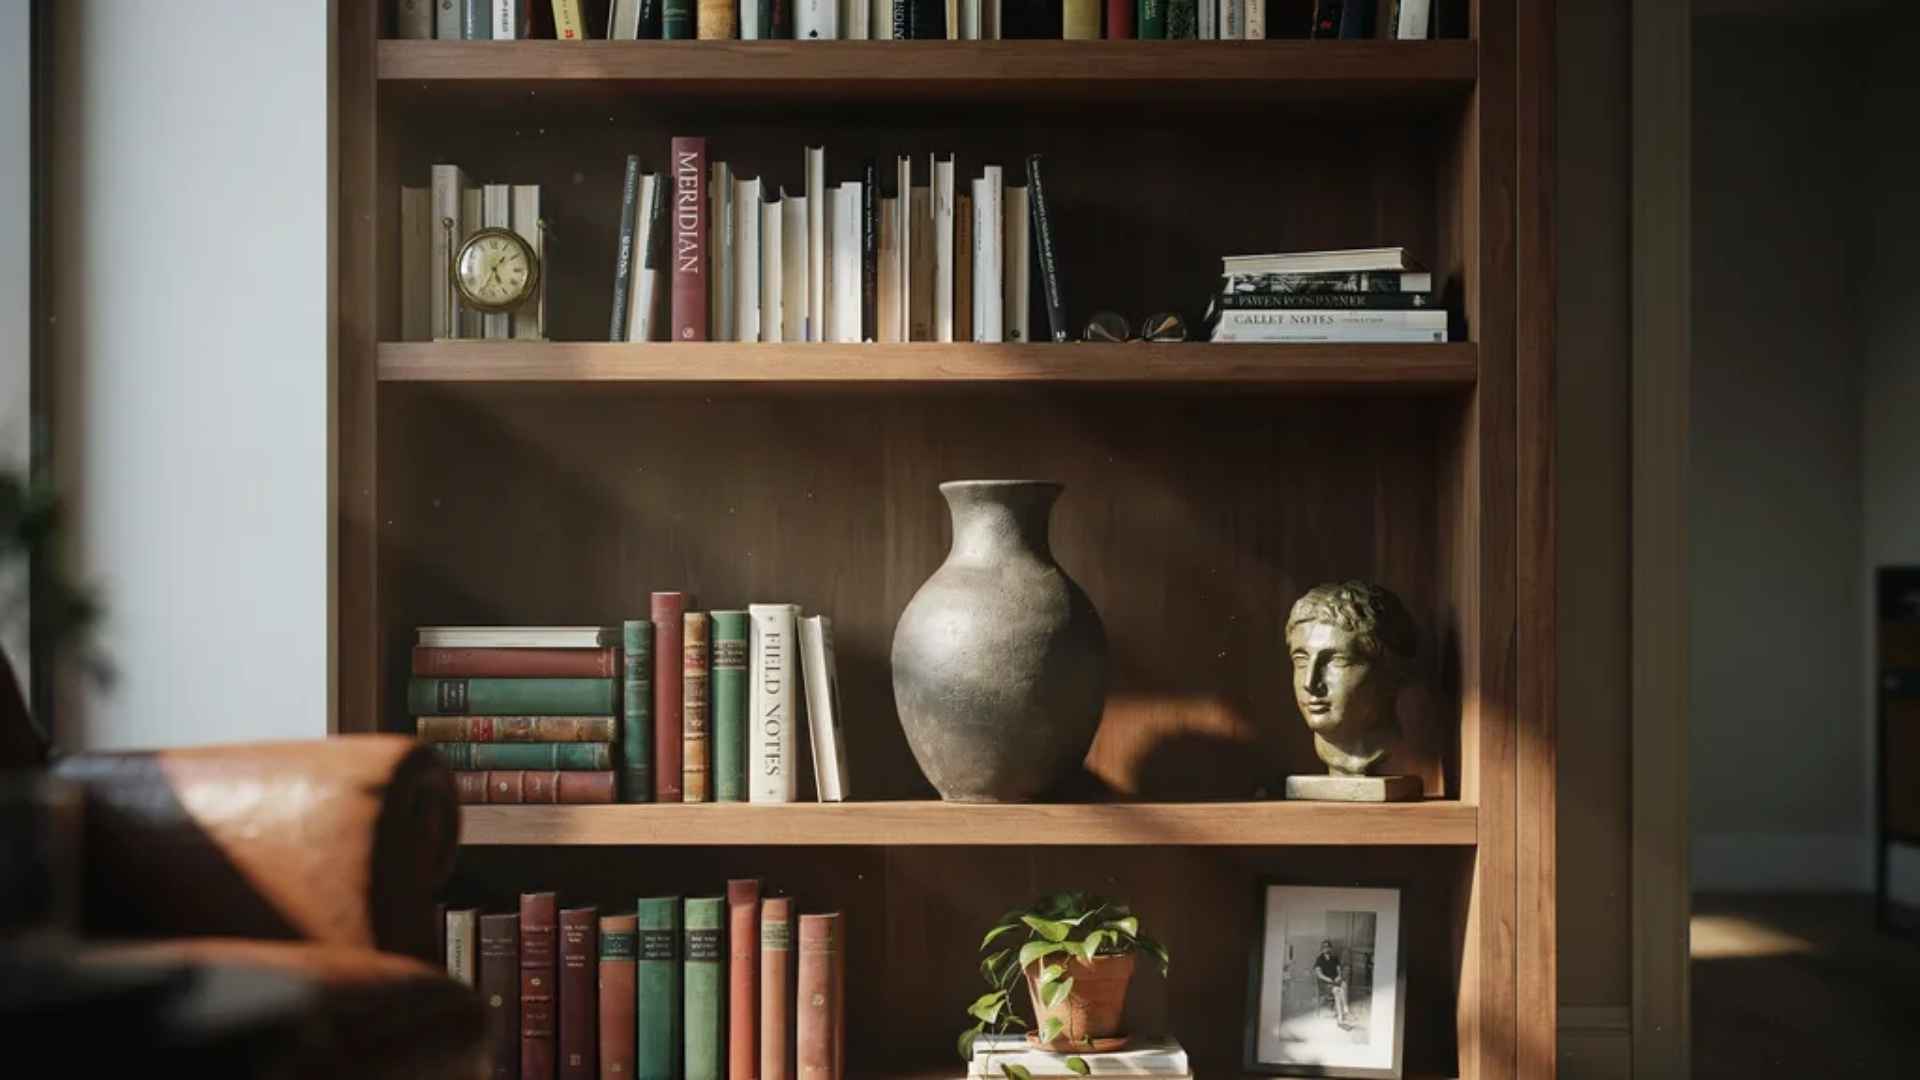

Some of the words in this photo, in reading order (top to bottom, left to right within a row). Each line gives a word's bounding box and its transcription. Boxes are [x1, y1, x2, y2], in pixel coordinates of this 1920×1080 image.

[678, 151, 698, 273] MERIDIAN
[1289, 314, 1335, 326] NOTES
[764, 633, 781, 695] FIELD
[764, 703, 781, 776] NOTES
